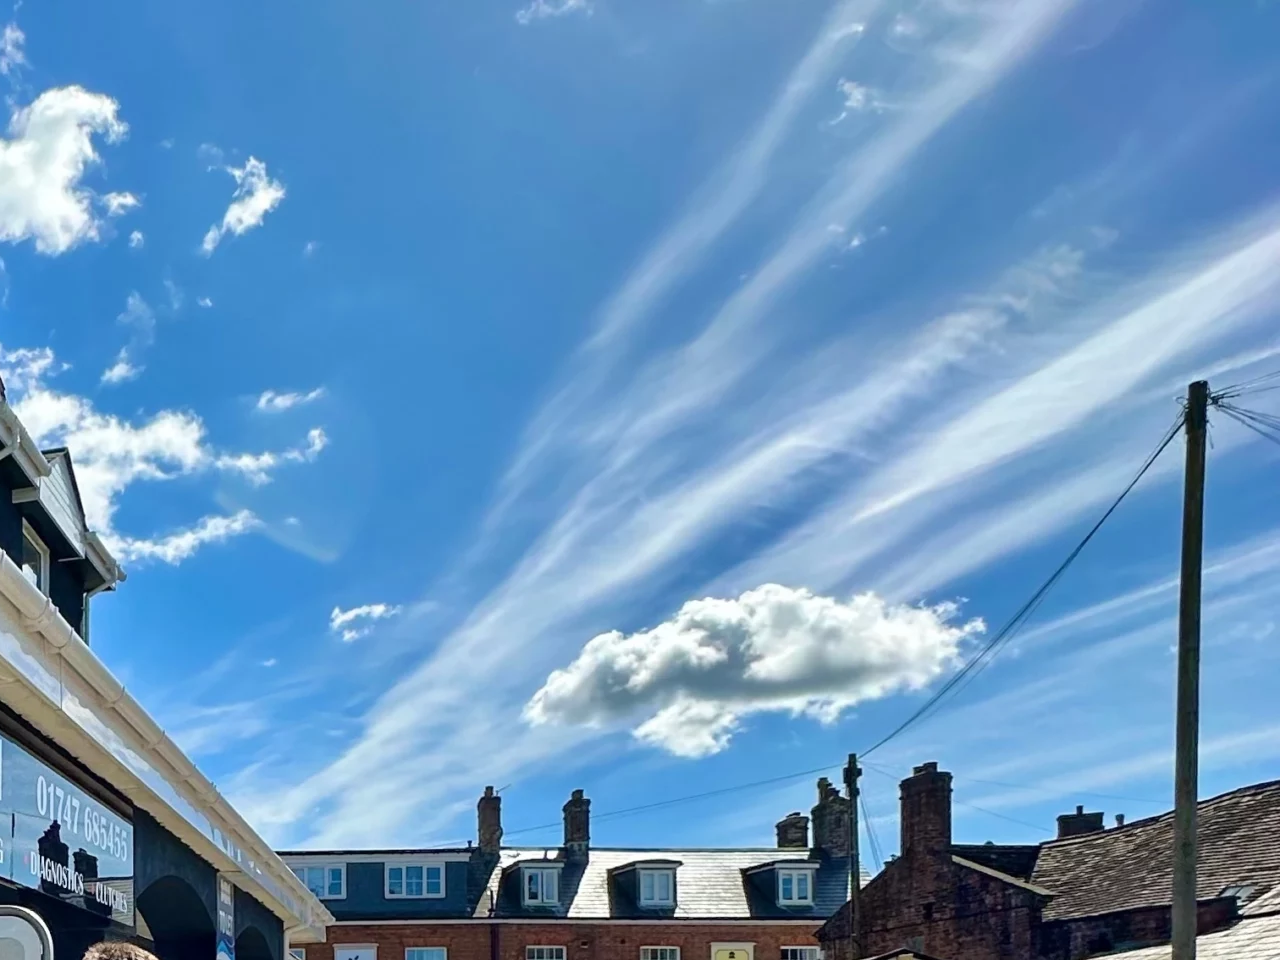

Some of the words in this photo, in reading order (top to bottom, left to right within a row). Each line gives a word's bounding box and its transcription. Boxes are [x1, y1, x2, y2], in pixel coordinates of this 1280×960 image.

[36, 775, 80, 834] 01747
[84, 807, 128, 862] 685455
[30, 851, 84, 896] DIAGNOSTICS
[95, 882, 128, 914] CLUTCHES
